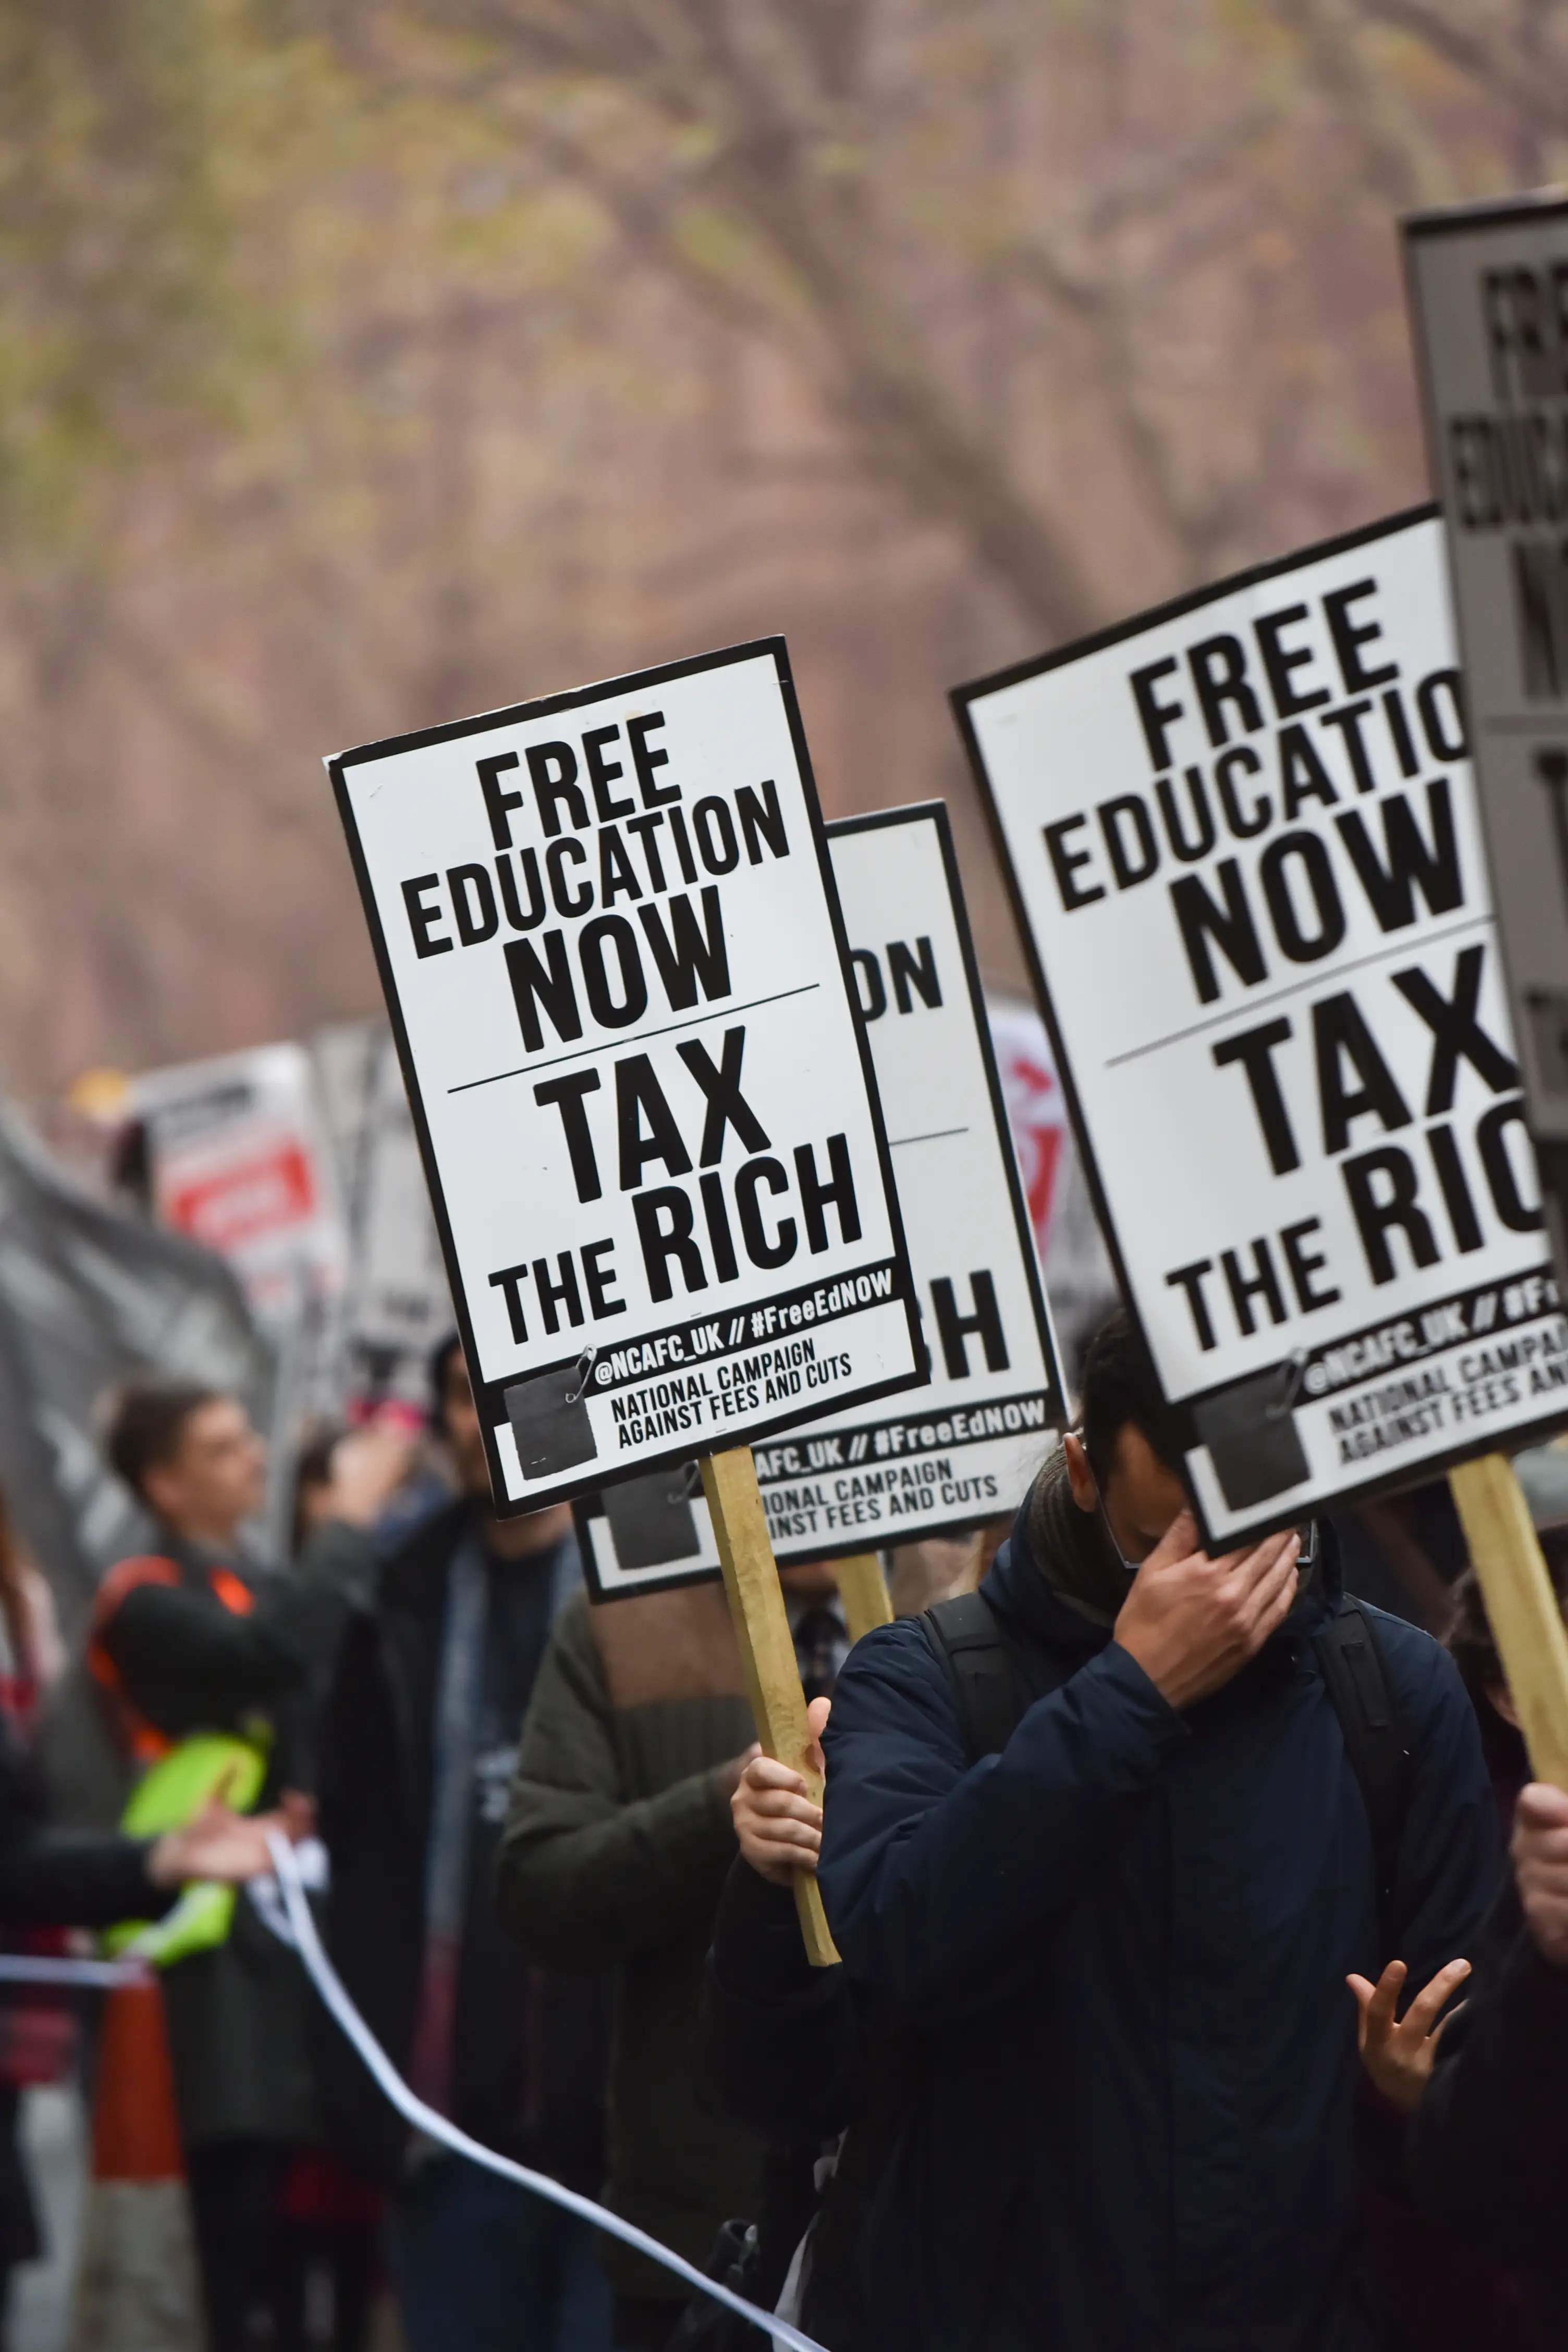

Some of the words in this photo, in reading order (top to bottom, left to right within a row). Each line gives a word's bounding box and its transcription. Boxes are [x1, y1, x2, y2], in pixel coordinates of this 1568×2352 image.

[1129, 577, 1401, 772] FREE
[476, 710, 682, 850] FREE
[1042, 667, 1472, 912] EDUCATIO
[401, 779, 790, 959] EDUCATION
[1169, 778, 1465, 1005] NOW
[503, 885, 732, 1053] NOW
[533, 1025, 771, 1204] TAX
[1212, 944, 1524, 1177] TAX
[488, 1238, 627, 1345] THE
[632, 1132, 862, 1304] RICH
[1166, 1215, 1340, 1351] THE
[1342, 1099, 1546, 1287] RIC
[595, 1322, 725, 1385] @NCAFC_UK
[728, 1317, 745, 1346] //
[751, 1269, 892, 1338] #FreeEdNOW
[611, 1373, 713, 1423] NATIONAL
[717, 1338, 816, 1390] CAMPAIGN
[619, 1401, 703, 1449] AGAINST
[709, 1388, 760, 1420] FEES
[765, 1370, 801, 1404] AND
[807, 1353, 852, 1388] CUTS
[1329, 1366, 1453, 1434] NATIONAL
[754, 1439, 844, 1481] AFC_UK
[848, 1433, 868, 1461] //
[874, 1399, 1045, 1456] #FreeEdNOW
[763, 1486, 828, 1515] IONAL
[835, 1458, 953, 1503] CAMPAIGN
[1339, 1395, 1444, 1465] AGAINST
[1452, 1375, 1521, 1423] FEES
[1528, 1358, 1568, 1395] AN
[768, 1510, 819, 1540] INST
[826, 1499, 881, 1530] FEES
[889, 1488, 934, 1516] AND
[941, 1476, 998, 1504] CUTS
